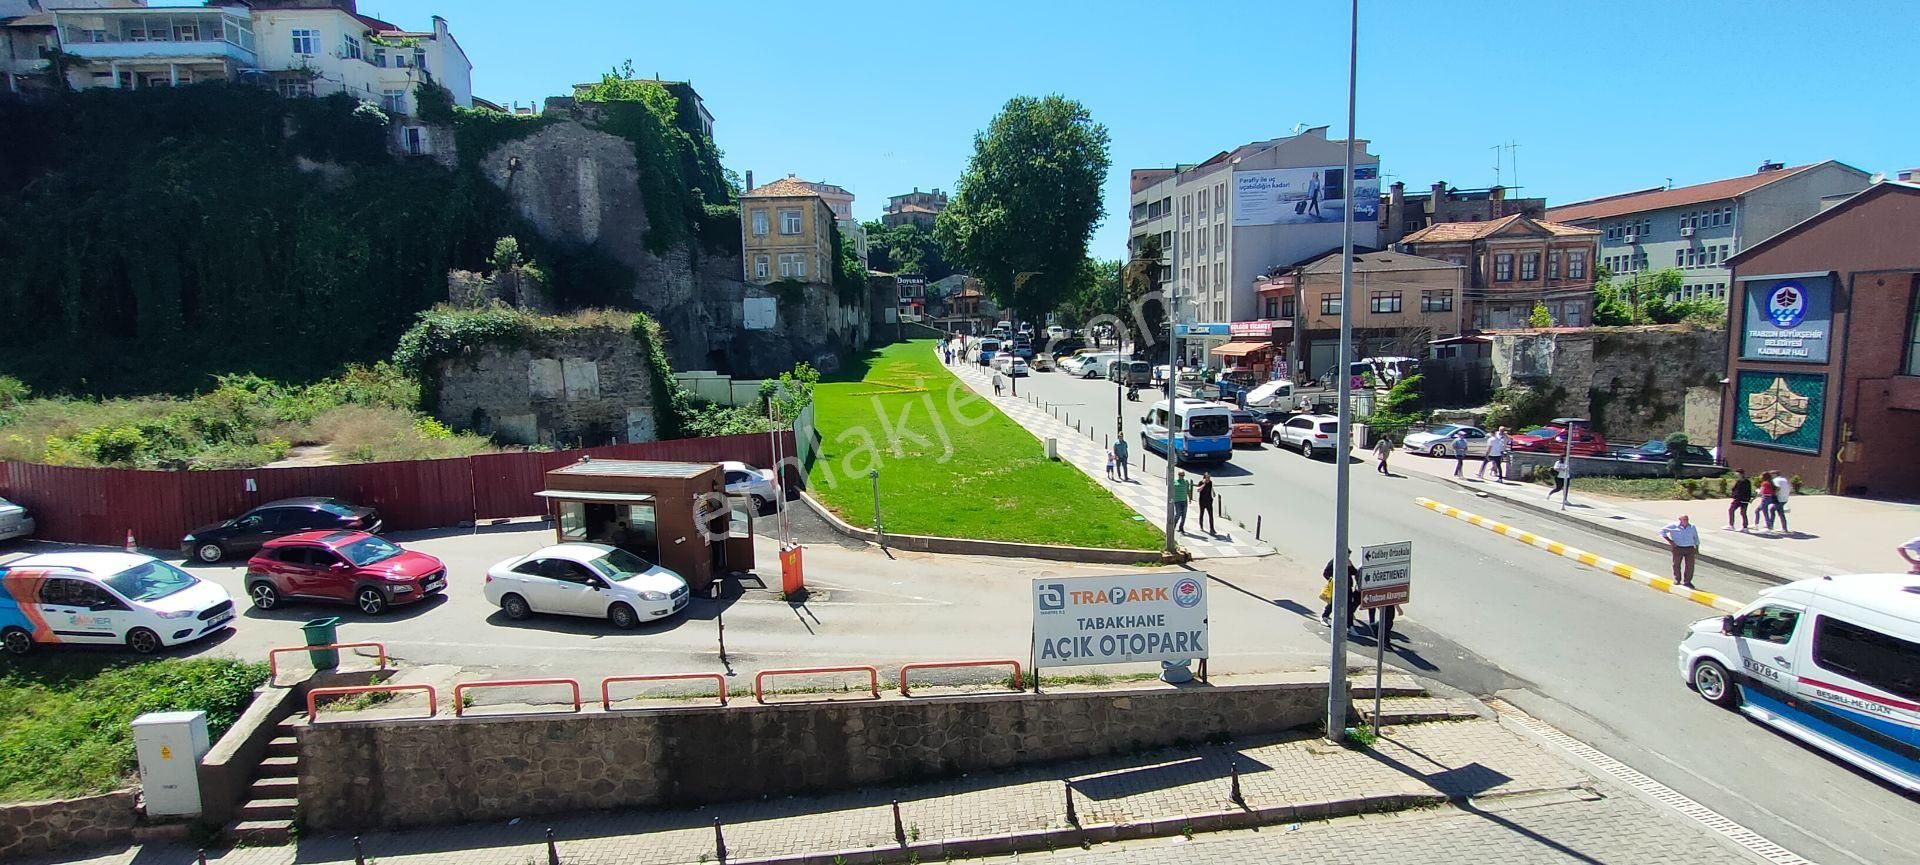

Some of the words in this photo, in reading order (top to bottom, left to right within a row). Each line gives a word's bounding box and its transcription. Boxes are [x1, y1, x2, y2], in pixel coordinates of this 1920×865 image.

[1749, 330, 1778, 338] TRABZON
[1779, 329, 1823, 338] BÜYÜKŞEHİR
[1764, 338, 1803, 347] BELEDİYESİ
[1757, 348, 1791, 356] KADINLAR
[1792, 347, 1808, 356] HALİ
[1070, 587, 1169, 605] TRAPARK
[1077, 614, 1165, 630] TABAKHANE
[1041, 635, 1094, 661] AÇIK
[1099, 631, 1203, 656] OTOPARK
